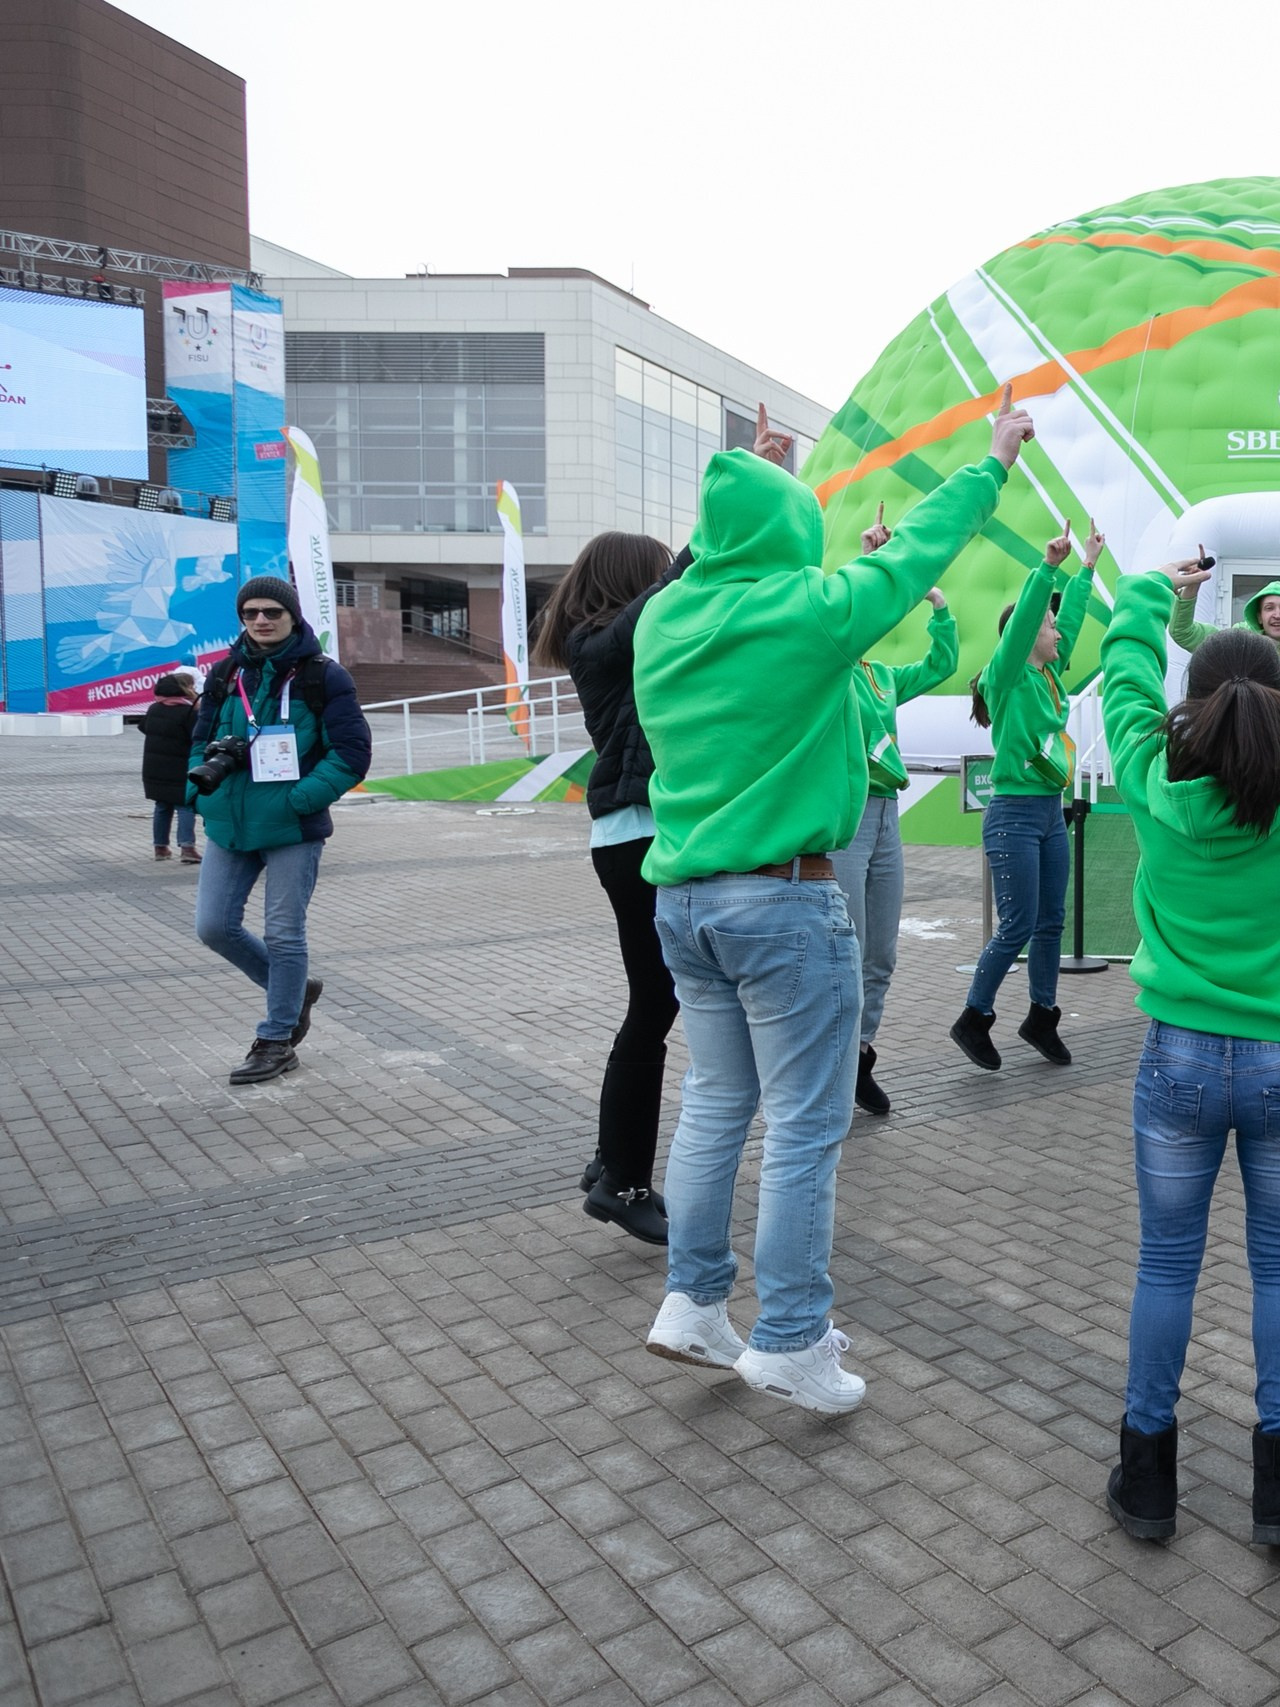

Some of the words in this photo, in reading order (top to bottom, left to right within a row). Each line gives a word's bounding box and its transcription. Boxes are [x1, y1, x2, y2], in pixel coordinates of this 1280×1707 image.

[188, 354, 209, 362] FISU
[0, 394, 26, 405] DAN
[975, 775, 993, 785] ВХО
